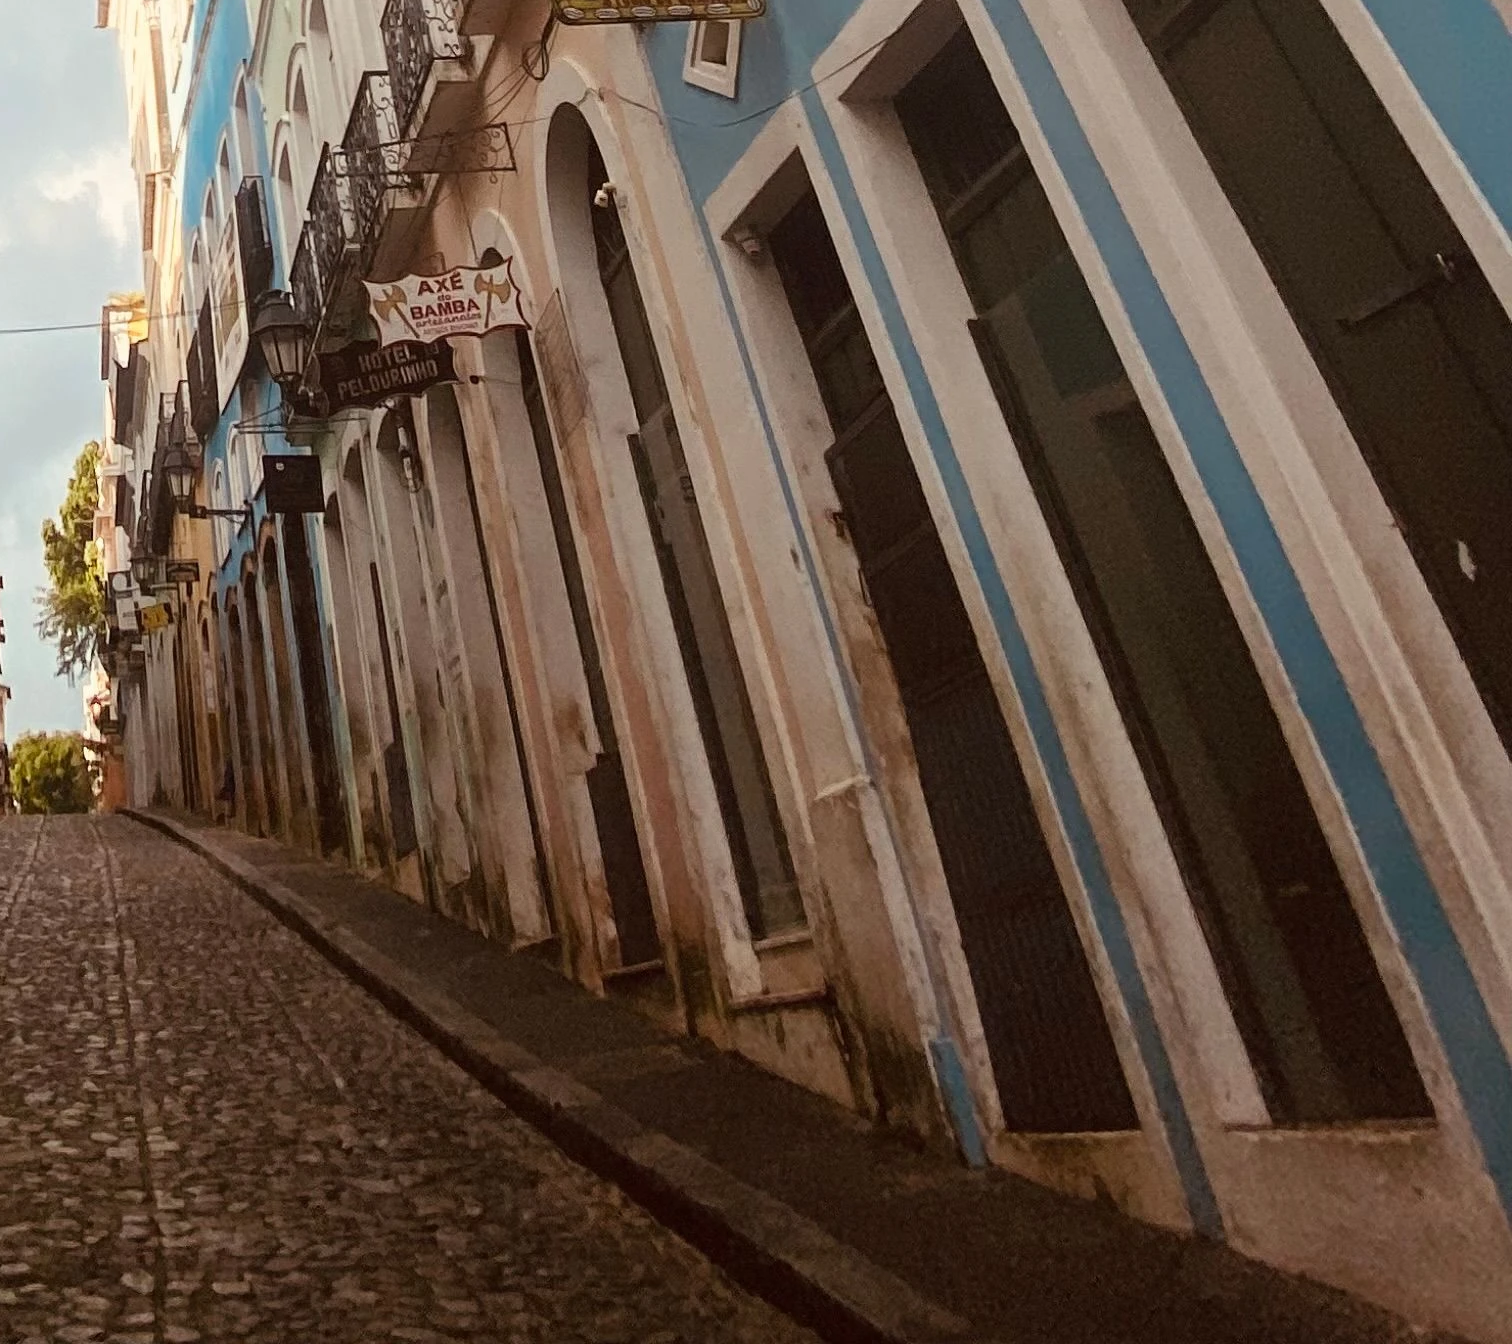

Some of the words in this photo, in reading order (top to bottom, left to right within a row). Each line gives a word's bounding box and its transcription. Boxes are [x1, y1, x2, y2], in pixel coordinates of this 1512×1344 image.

[417, 272, 464, 296] AXÉ
[410, 298, 480, 320] BAMBA
[358, 343, 417, 372] HOTEL
[337, 358, 439, 401] PELOURINHO
